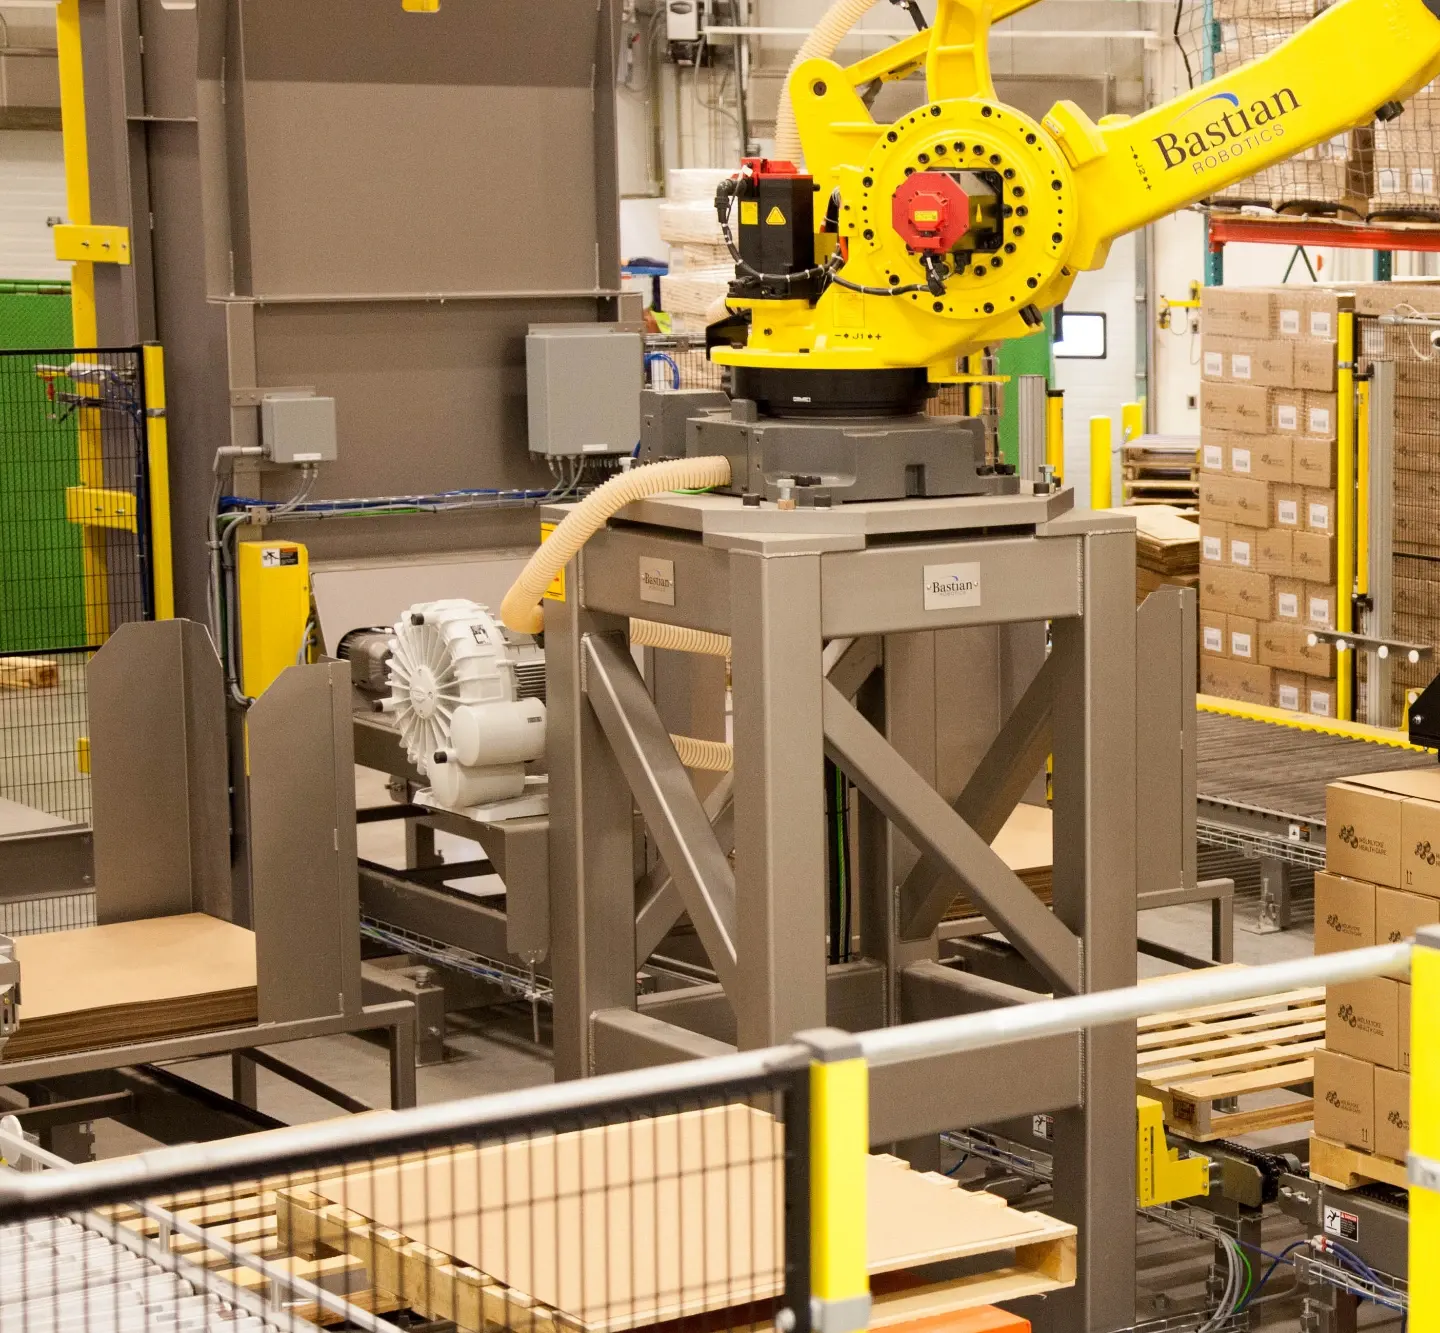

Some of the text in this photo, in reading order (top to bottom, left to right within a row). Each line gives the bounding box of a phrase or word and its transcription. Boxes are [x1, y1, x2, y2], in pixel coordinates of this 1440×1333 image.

[1152, 87, 1302, 171] Bastian
[1192, 123, 1286, 175] ROBOTICS
[644, 572, 670, 588] Bastian
[932, 581, 973, 593] Bastian
